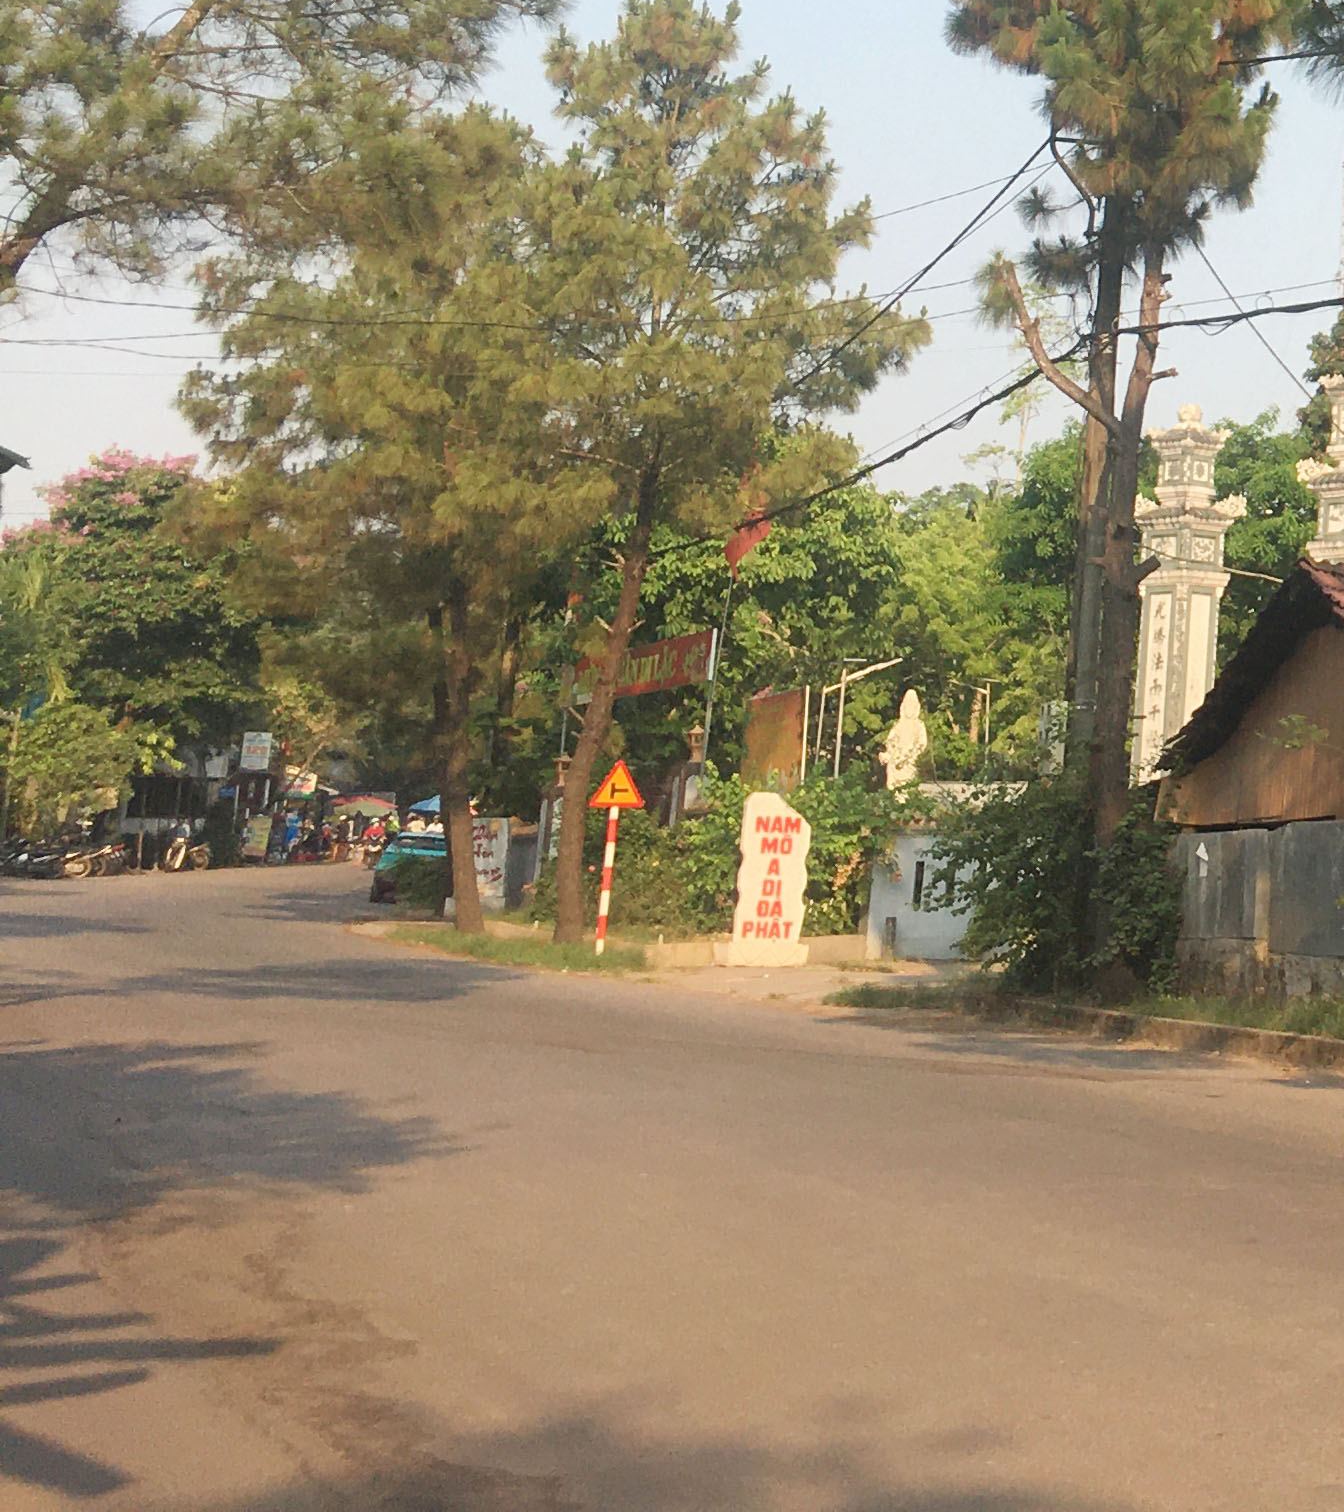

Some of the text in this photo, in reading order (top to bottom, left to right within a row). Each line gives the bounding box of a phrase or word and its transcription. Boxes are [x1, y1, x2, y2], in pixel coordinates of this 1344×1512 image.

[755, 815, 802, 834] NAM
[767, 857, 780, 876] A
[741, 918, 794, 942] PHẬT
